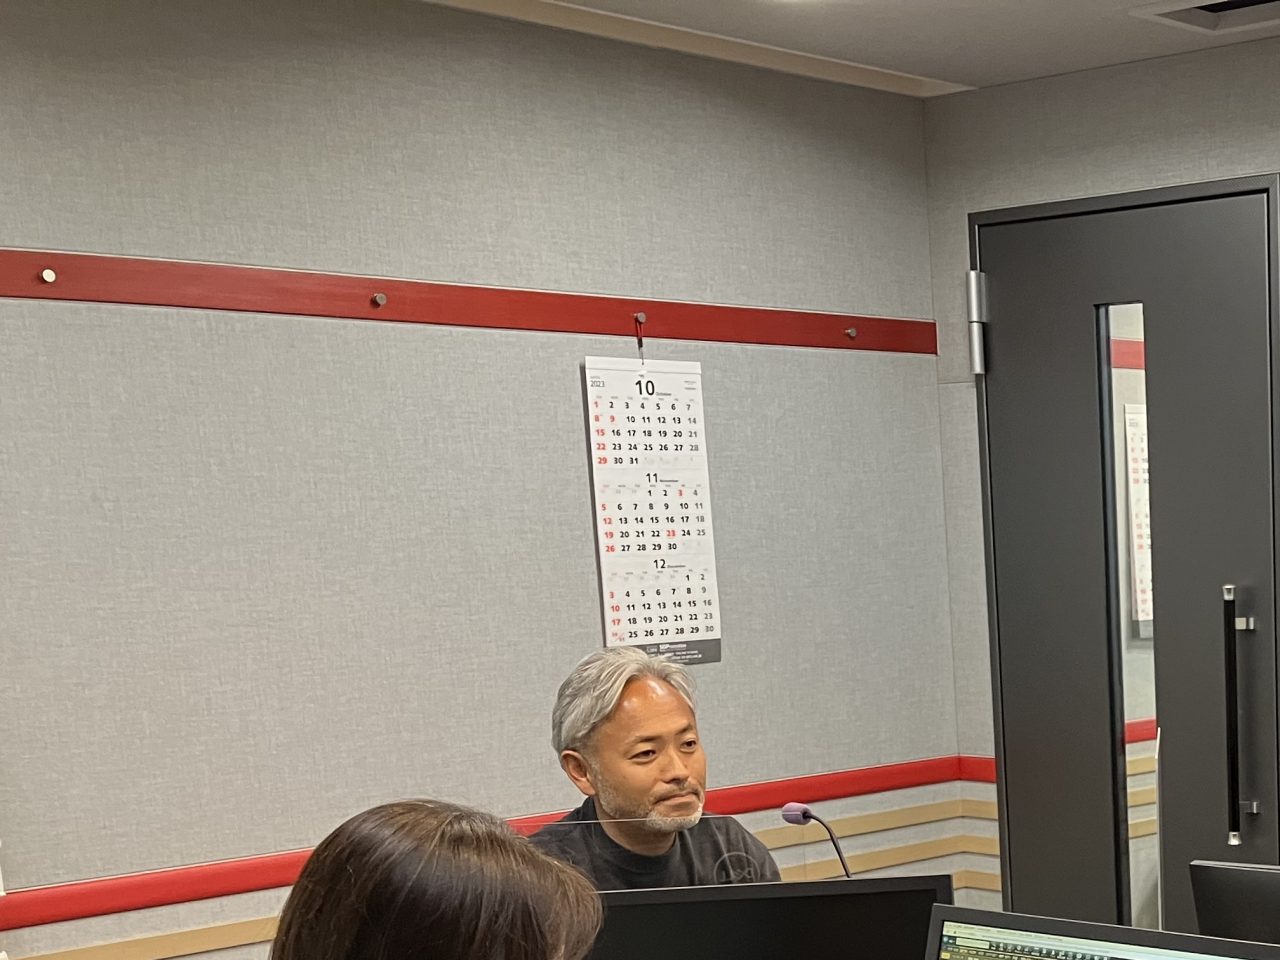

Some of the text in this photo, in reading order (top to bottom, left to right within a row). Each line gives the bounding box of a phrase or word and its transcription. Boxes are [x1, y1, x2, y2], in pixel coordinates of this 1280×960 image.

[634, 380, 656, 396] 10
[597, 457, 608, 465] 29
[646, 473, 658, 484] 11
[654, 558, 666, 569] 12
